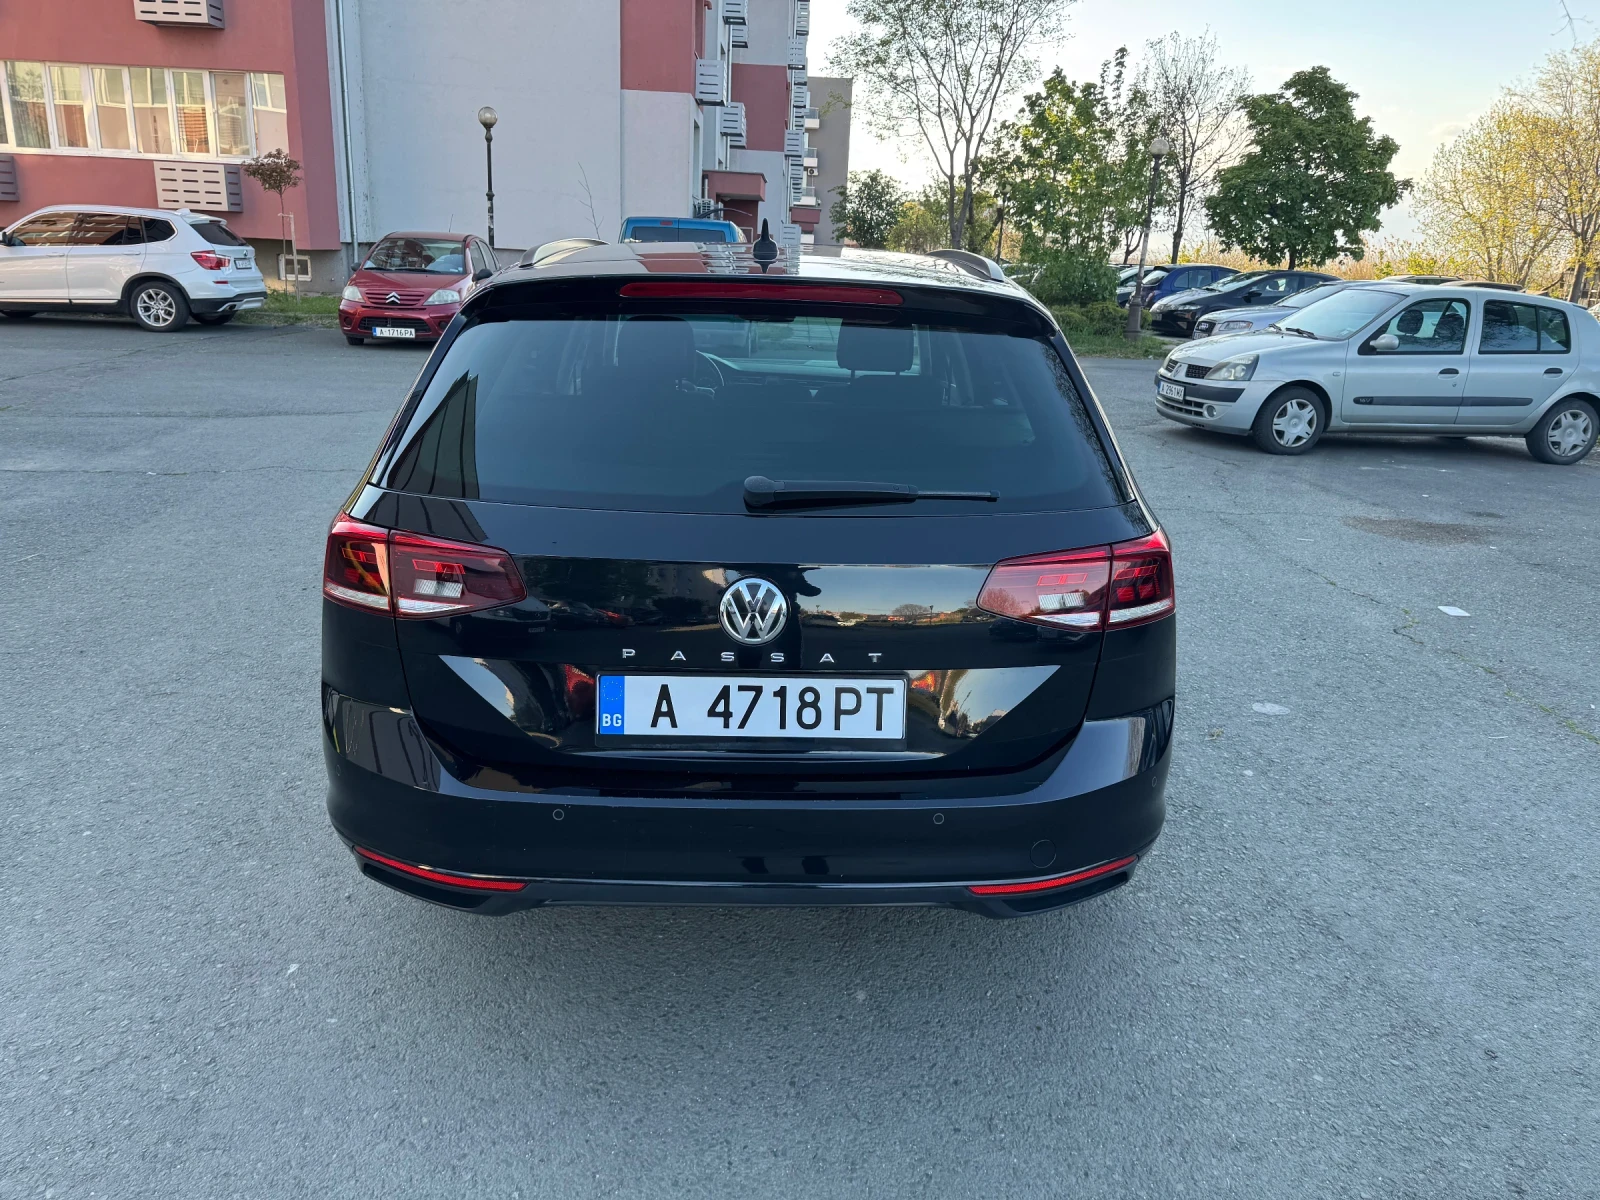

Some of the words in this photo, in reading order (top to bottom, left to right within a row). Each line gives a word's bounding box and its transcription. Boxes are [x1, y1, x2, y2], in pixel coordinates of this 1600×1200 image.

[622, 648, 882, 663] PASSAT
[650, 683, 678, 728] A
[707, 684, 895, 731] 4718PT
[602, 713, 623, 727] BG
